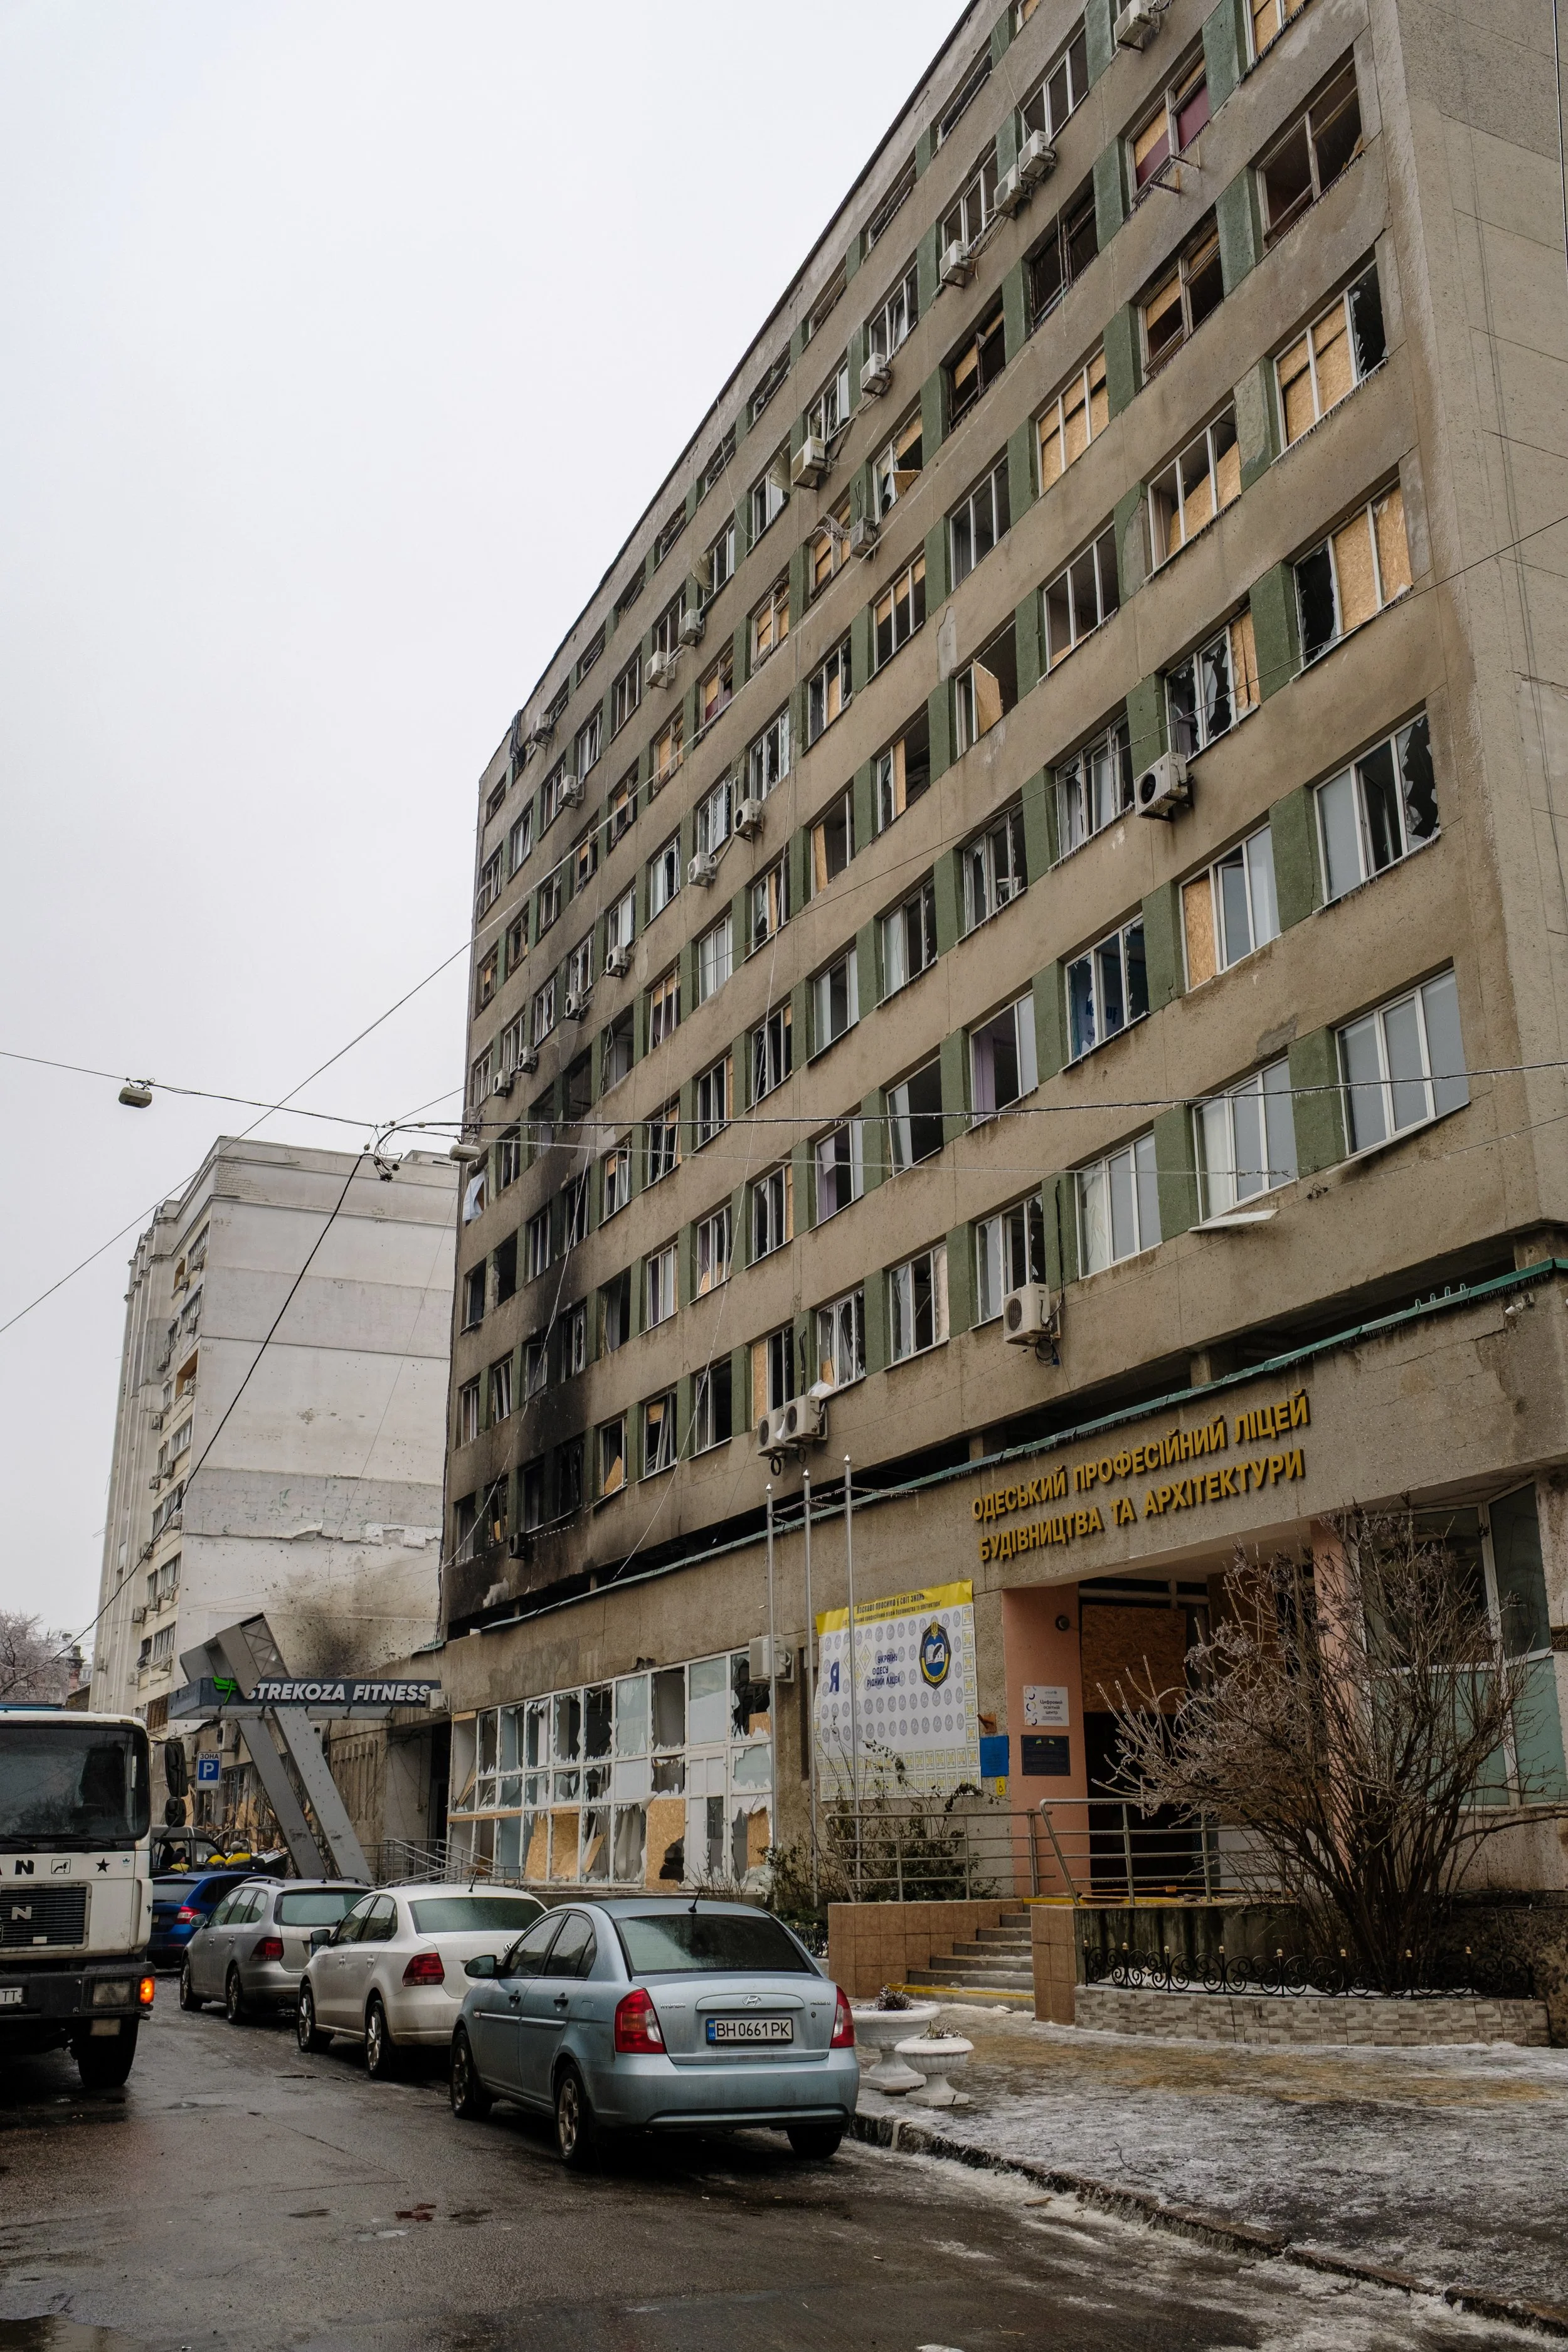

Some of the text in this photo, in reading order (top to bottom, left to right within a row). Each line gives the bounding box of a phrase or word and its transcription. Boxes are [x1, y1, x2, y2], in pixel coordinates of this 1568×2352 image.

[972, 1389, 1308, 1522] ОДЕСЬКИЙ ПРОФЕСІЙНИЙ ЛІЦЕЙ
[978, 1449, 1304, 1561] БУДІВНИЦТВА ТА АРХІТЕКТУРИ
[900, 1596, 909, 1605] світ
[877, 1652, 898, 1664] УКРАЇНУ
[829, 1661, 840, 1693] Я
[872, 1666, 889, 1675] ОДЕСУ
[867, 1675, 901, 1687] РІДНИЙ ЛІЦЕЙ
[352, 1684, 431, 1701] FITNESS
[203, 1762, 215, 1778] P
